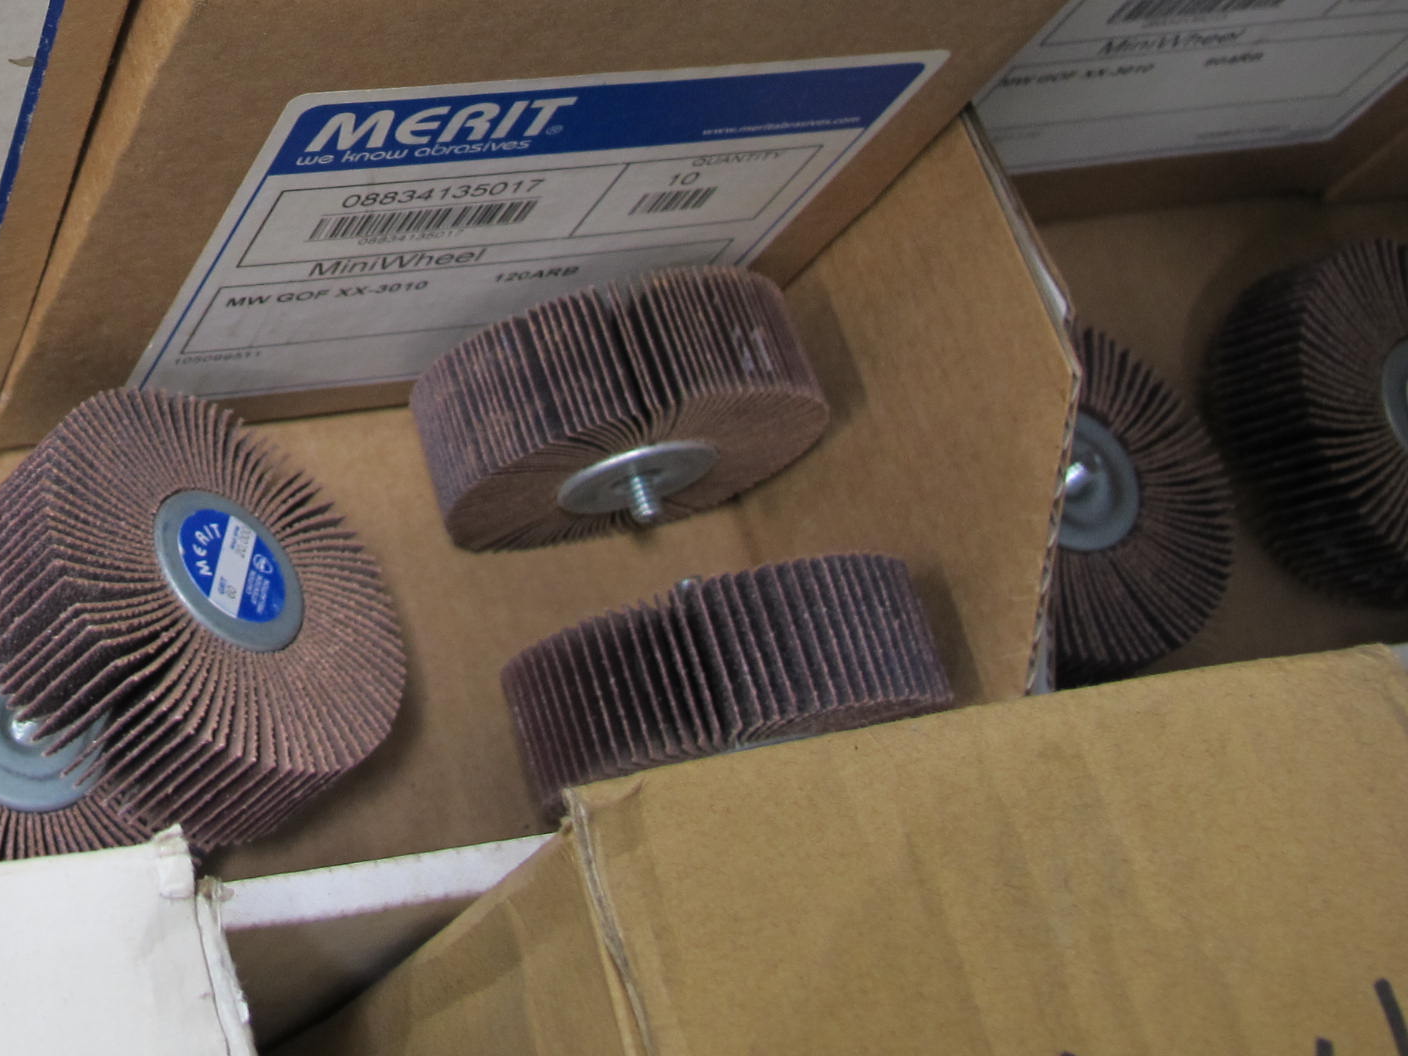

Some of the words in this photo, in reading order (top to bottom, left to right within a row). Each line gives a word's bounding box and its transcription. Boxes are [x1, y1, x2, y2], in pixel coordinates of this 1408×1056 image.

[295, 153, 333, 167] we
[341, 147, 409, 163] know
[414, 139, 533, 157] abrasives
[691, 151, 783, 167] QUANTITY
[341, 178, 546, 209] 08834135017
[667, 171, 701, 186] 10
[307, 247, 488, 278] MiniWheel
[225, 294, 271, 308] MW
[275, 288, 331, 304] GOF
[334, 280, 430, 298] XX-3010
[494, 266, 580, 284] 120ARB
[192, 522, 223, 577] MERIT
